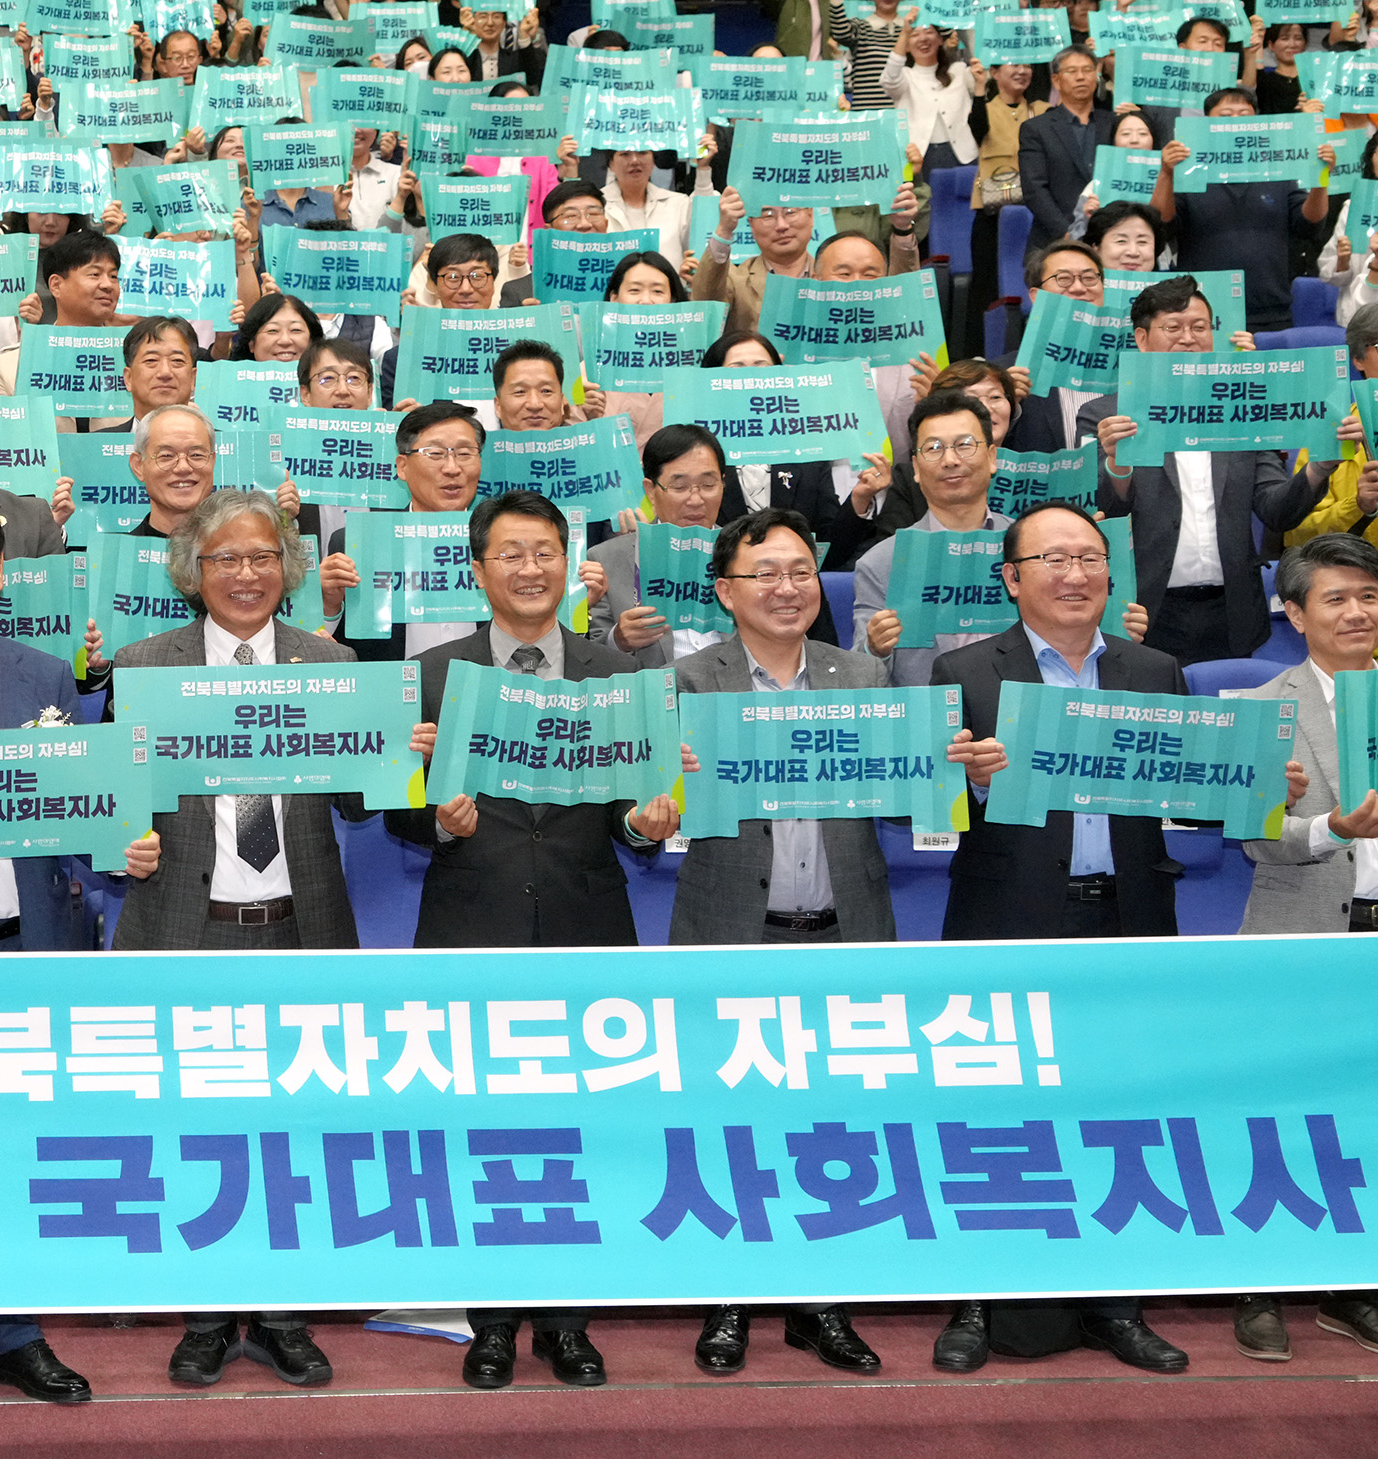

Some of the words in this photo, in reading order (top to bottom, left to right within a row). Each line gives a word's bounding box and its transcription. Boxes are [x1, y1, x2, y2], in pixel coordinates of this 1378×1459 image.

[799, 289, 872, 301] 전북특별자치도의
[828, 308, 874, 325] 우리는
[774, 323, 839, 344] 국가대표
[844, 321, 923, 344] 사회복지사
[468, 336, 509, 354] 우리는
[1172, 363, 1264, 375] 전북특별자치도의
[1268, 361, 1304, 372] 자부심!
[711, 377, 794, 390] 전북특별자치도의
[797, 374, 833, 387] 자부심!
[1211, 382, 1267, 401] 우리는
[750, 396, 799, 414] 우리는
[1148, 405, 1224, 424] 국가대표
[1230, 401, 1327, 422] 사회복지사
[769, 413, 858, 435] 사회복지사
[181, 679, 301, 696] 전북특별자치도의
[306, 678, 356, 693] 자부심!
[500, 685, 588, 711] 전북특별자치도의
[235, 704, 306, 728] 우리는
[742, 705, 855, 721] 전북특별자치도의
[860, 703, 905, 718] 자부심!
[1066, 702, 1183, 724] 전북특별자치도의
[1187, 711, 1234, 726] 자부심!
[536, 718, 592, 743] 우리는
[791, 729, 859, 753] 우리는
[38, 741, 87, 757] 자부심!
[156, 735, 252, 759] 국가대표
[260, 731, 384, 757] 사회복지사
[469, 732, 551, 769] 국가대표
[552, 738, 651, 771] 사회복지사
[1112, 729, 1183, 756] 우리는
[717, 759, 808, 784] 국가대표
[816, 756, 934, 781] 사회복지사
[1032, 751, 1126, 780] 국가대표
[1132, 759, 1255, 788] 사회복지사
[716, 992, 1061, 1089] 자부심!
[30, 1128, 601, 1252] 국가대표
[641, 1115, 1366, 1241] 사회복지사
